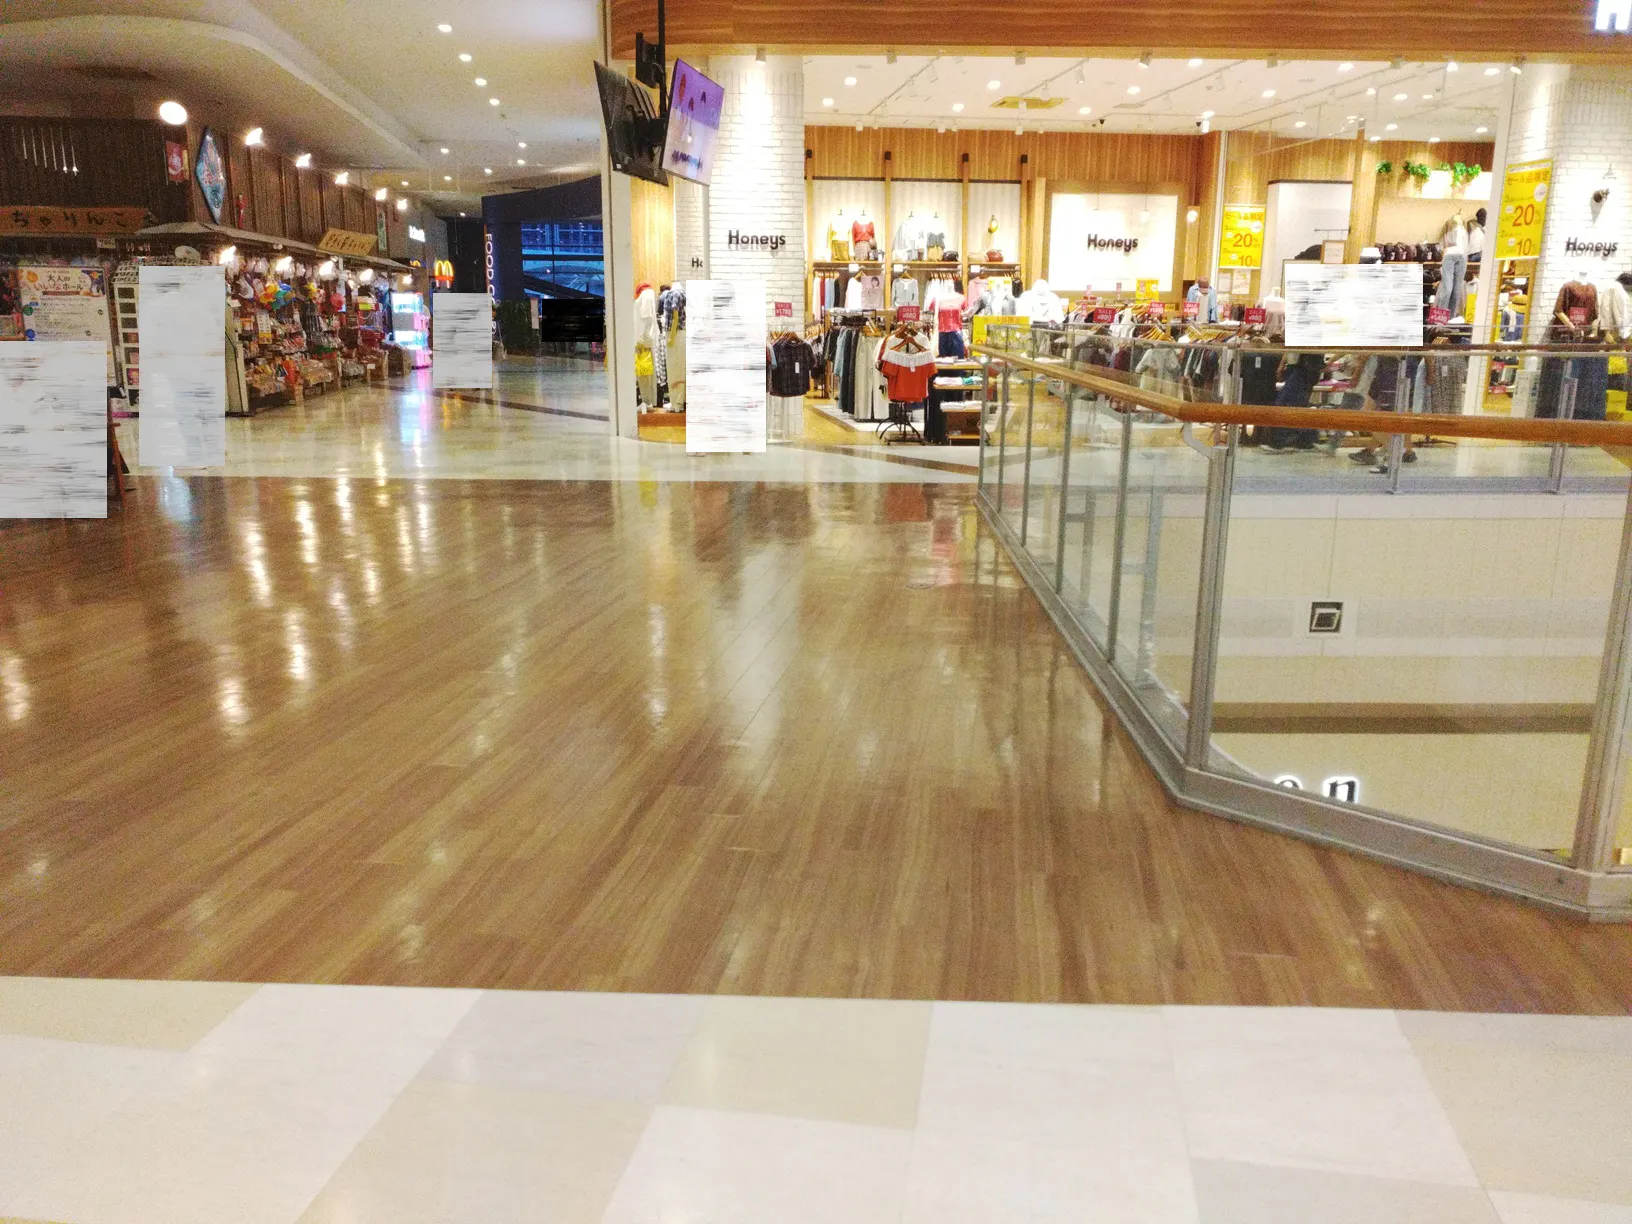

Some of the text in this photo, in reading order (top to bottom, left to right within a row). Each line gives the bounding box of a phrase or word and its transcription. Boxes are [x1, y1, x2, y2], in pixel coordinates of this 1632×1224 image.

[728, 229, 786, 250] Honeys
[1087, 233, 1138, 252] Honeys
[1565, 236, 1618, 257] Honeys
[485, 233, 494, 280] FOOD
